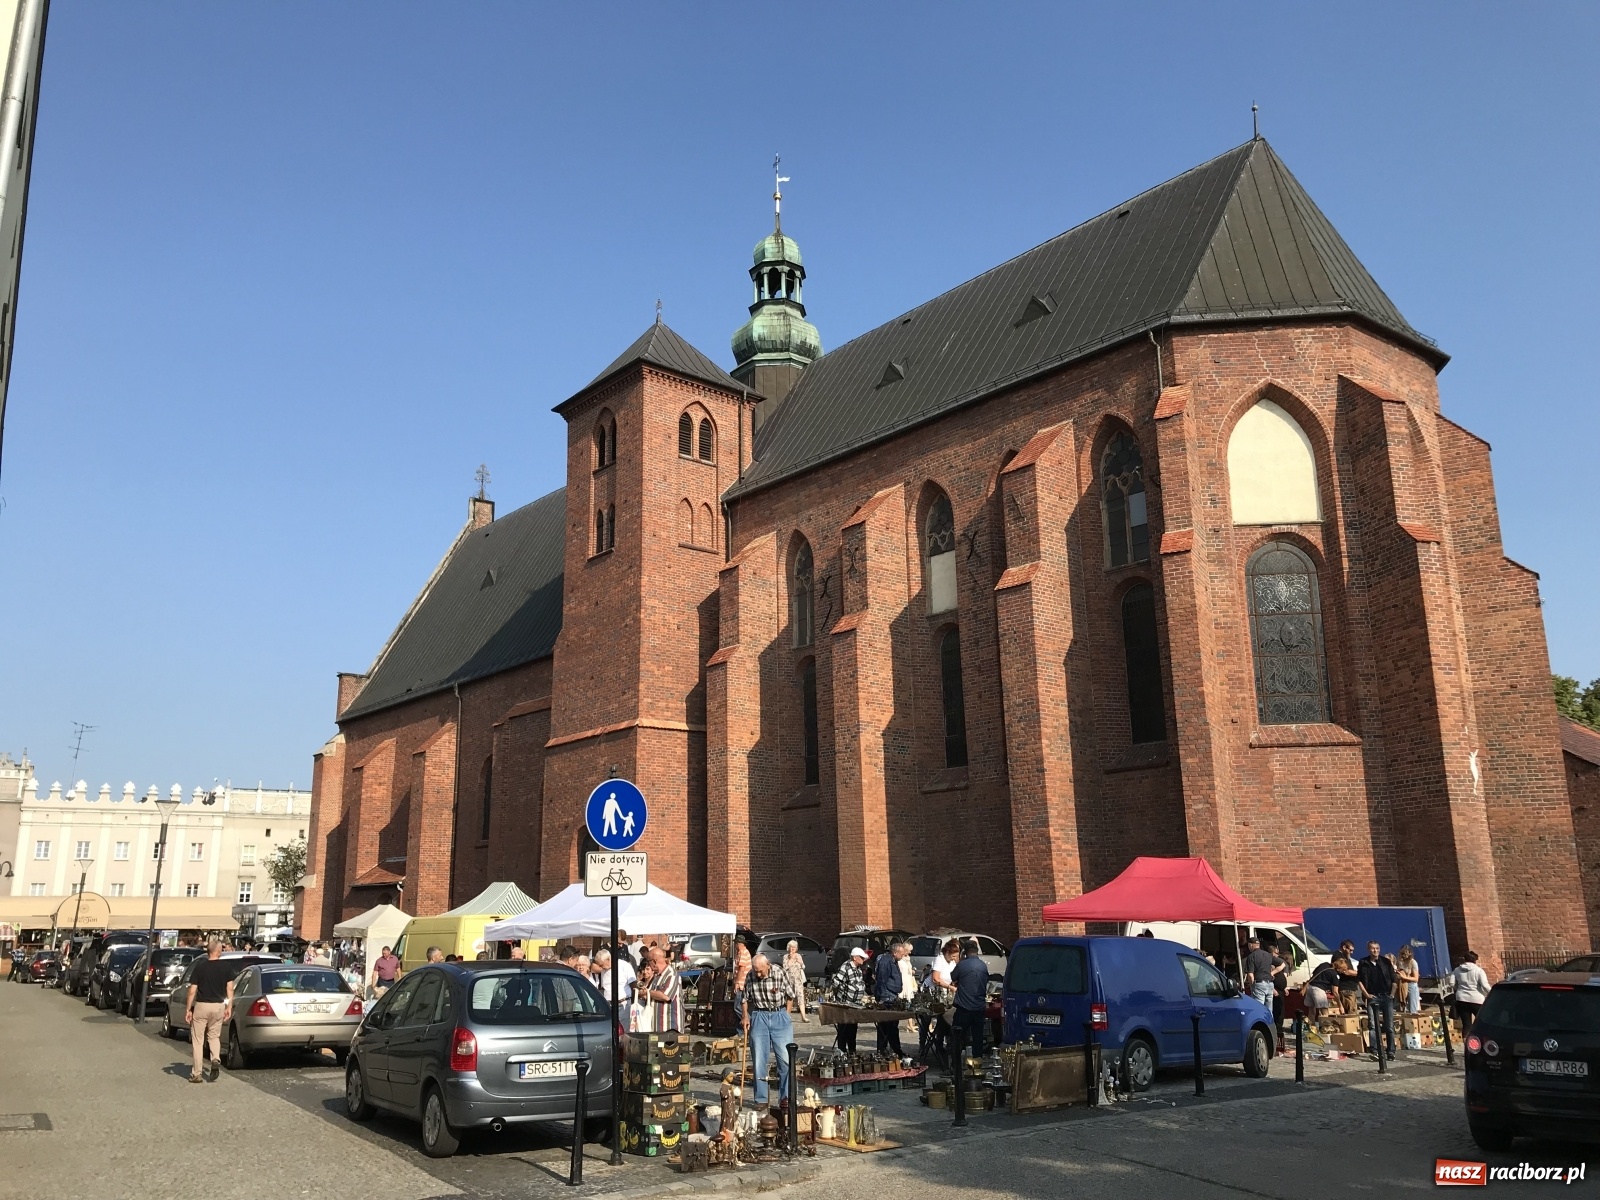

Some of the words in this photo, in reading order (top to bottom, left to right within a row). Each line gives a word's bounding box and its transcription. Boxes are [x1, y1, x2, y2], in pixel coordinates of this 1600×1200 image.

[590, 855, 606, 864] Nie
[609, 854, 645, 866] dotyczy
[527, 1062, 549, 1075] SRC
[1529, 1060, 1551, 1072] SRC
[1555, 1062, 1585, 1074] AR86
